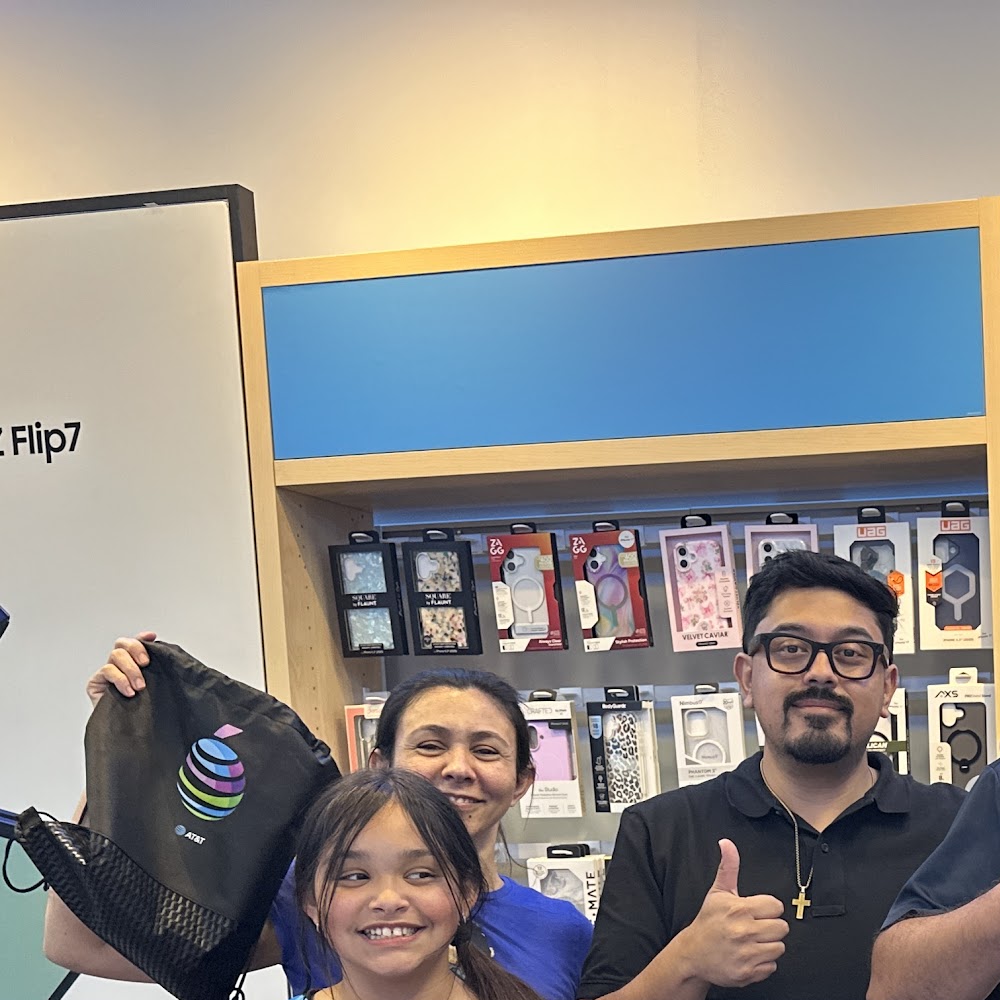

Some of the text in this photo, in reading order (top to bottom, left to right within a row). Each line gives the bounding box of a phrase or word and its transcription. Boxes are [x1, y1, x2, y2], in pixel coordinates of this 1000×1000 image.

[11, 421, 81, 464] Flip7
[704, 631, 728, 639] CAVIAR
[935, 690, 959, 698] AXS
[184, 832, 206, 845] AT&T
